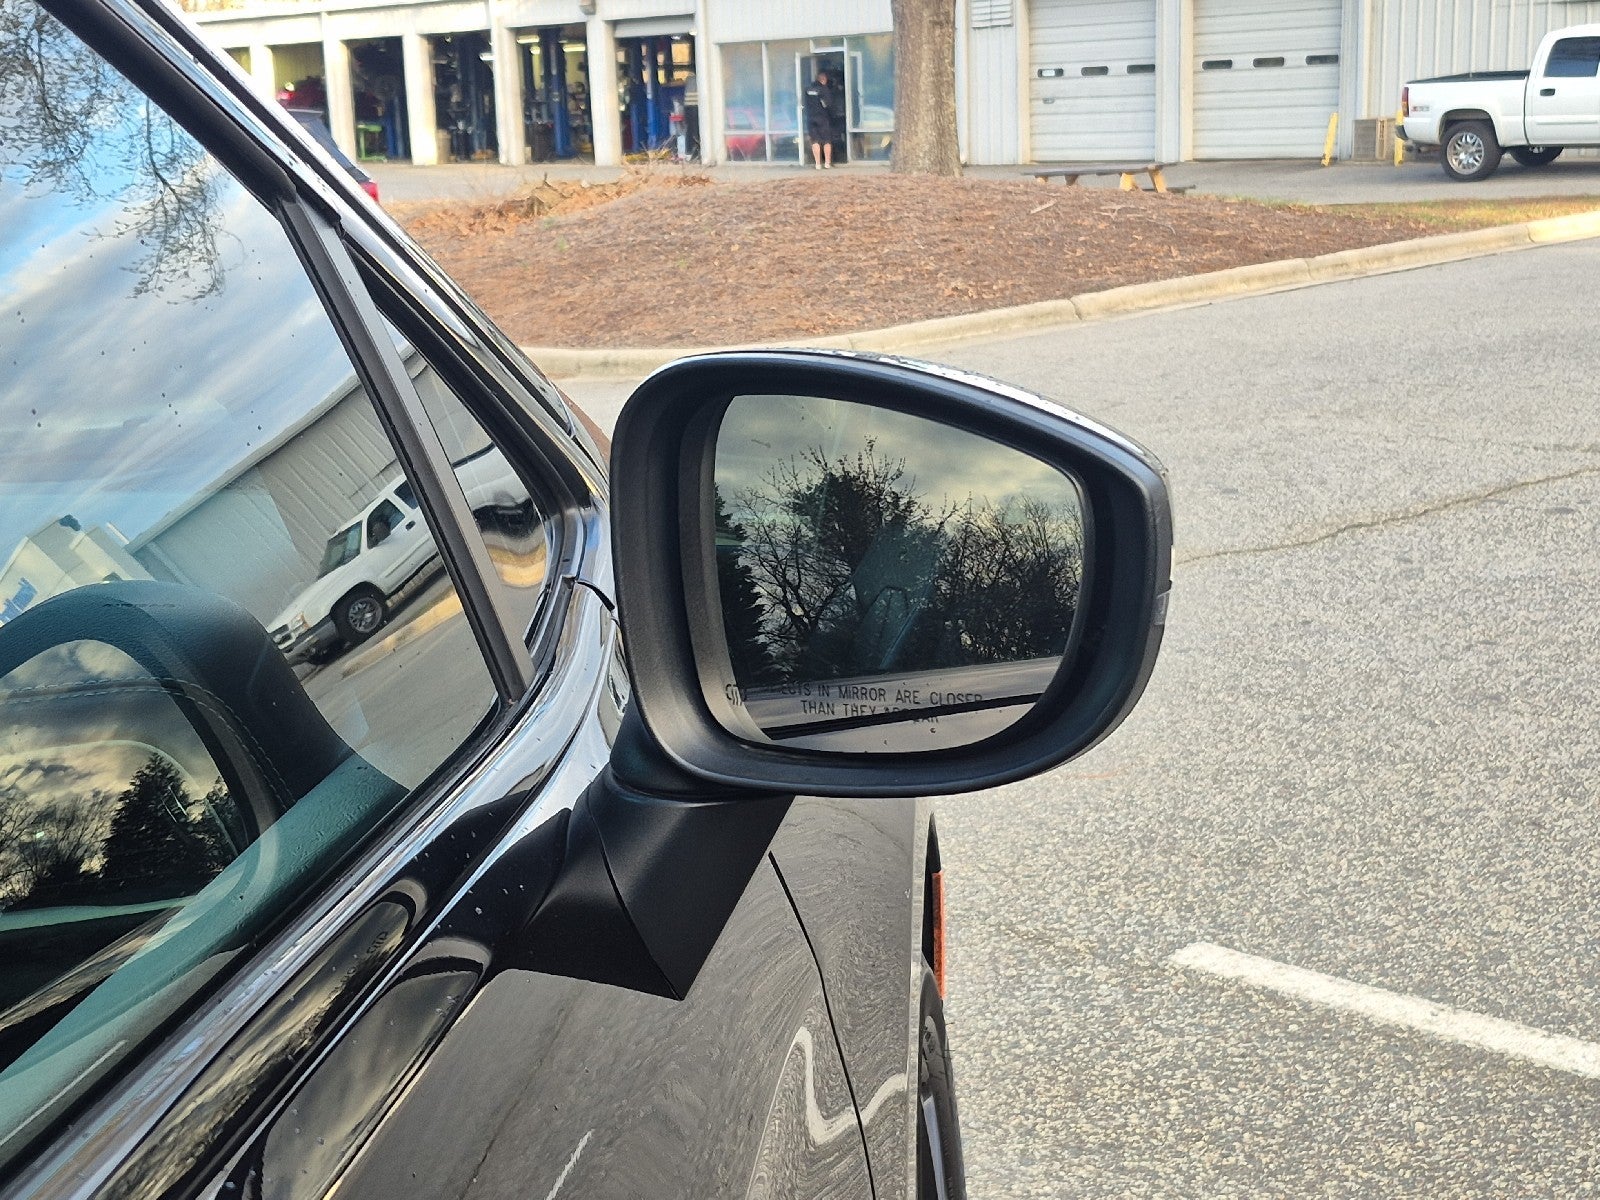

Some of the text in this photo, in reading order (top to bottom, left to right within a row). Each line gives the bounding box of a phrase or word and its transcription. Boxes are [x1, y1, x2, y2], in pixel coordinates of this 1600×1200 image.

[818, 684, 830, 698] IN
[838, 685, 887, 702] MIRROR
[895, 689, 921, 704] ARE
[801, 699, 835, 716] THAN
[843, 703, 877, 717] THEY
